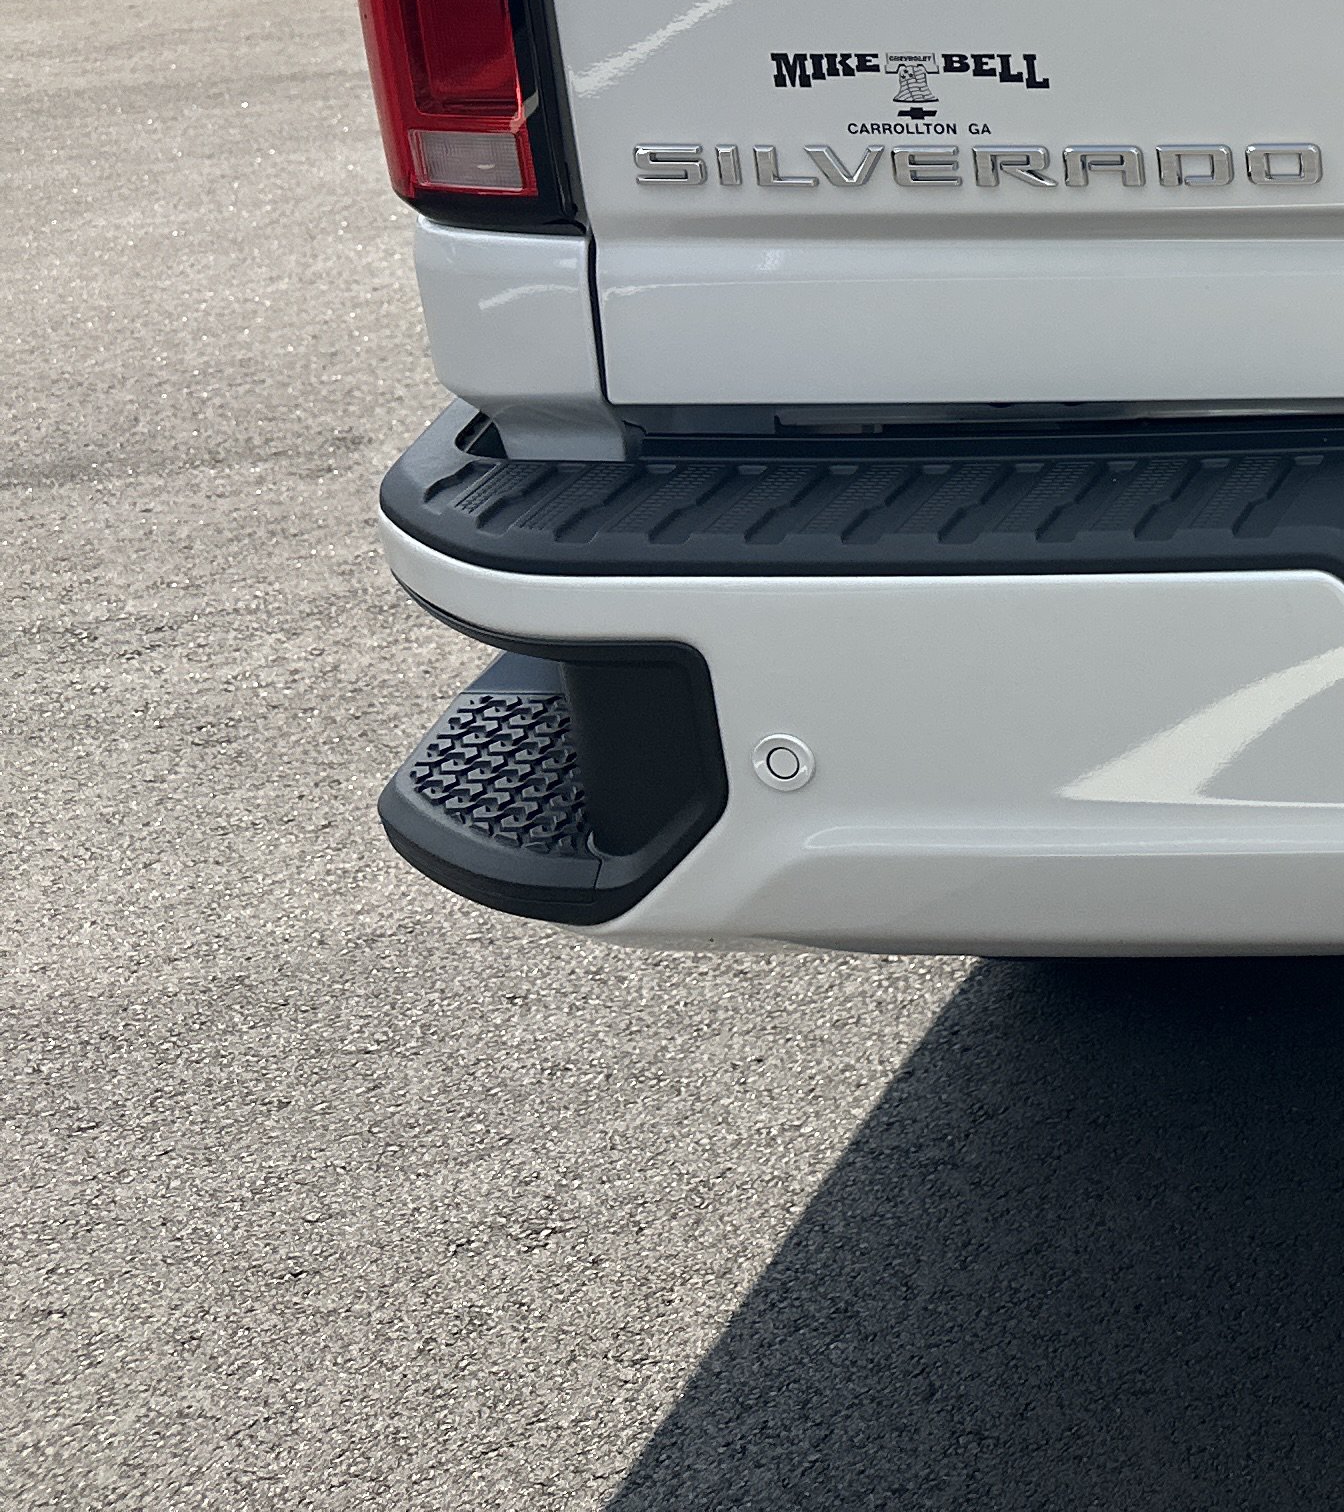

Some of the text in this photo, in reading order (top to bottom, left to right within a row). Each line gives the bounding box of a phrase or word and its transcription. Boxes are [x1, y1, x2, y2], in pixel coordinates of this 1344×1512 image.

[770, 53, 1049, 89] MIKE BELL
[847, 123, 992, 135] CARROLLTON GA
[633, 143, 1324, 189] SILVERADO
